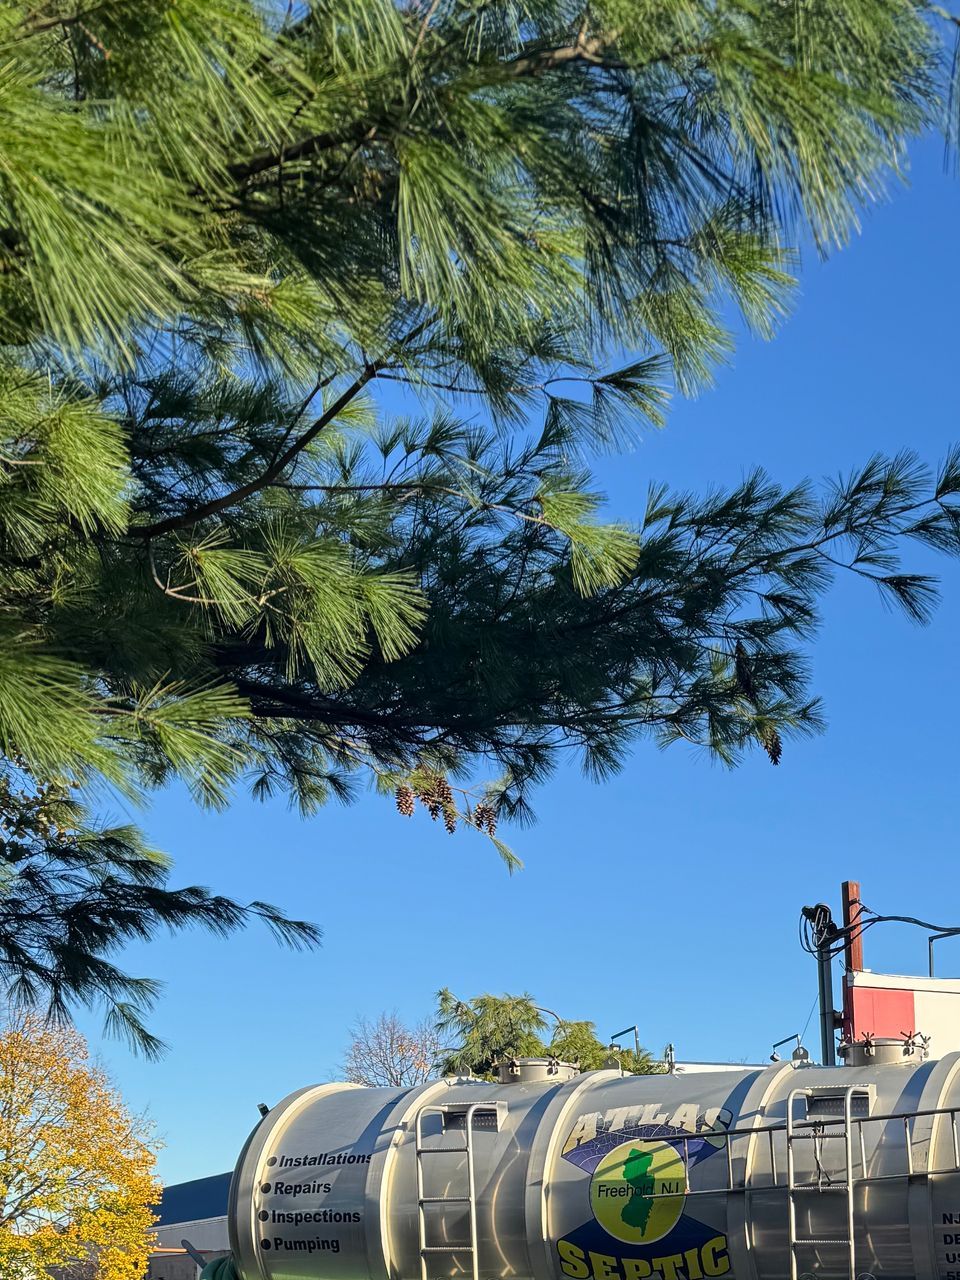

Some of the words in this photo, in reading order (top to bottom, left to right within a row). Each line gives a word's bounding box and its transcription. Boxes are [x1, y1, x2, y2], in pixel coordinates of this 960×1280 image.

[562, 1103, 734, 1156] ATLAS
[279, 1152, 373, 1168] Installations
[274, 1180, 332, 1198] Repairs
[271, 1208, 361, 1227] Inspections
[273, 1236, 340, 1254] Pumping
